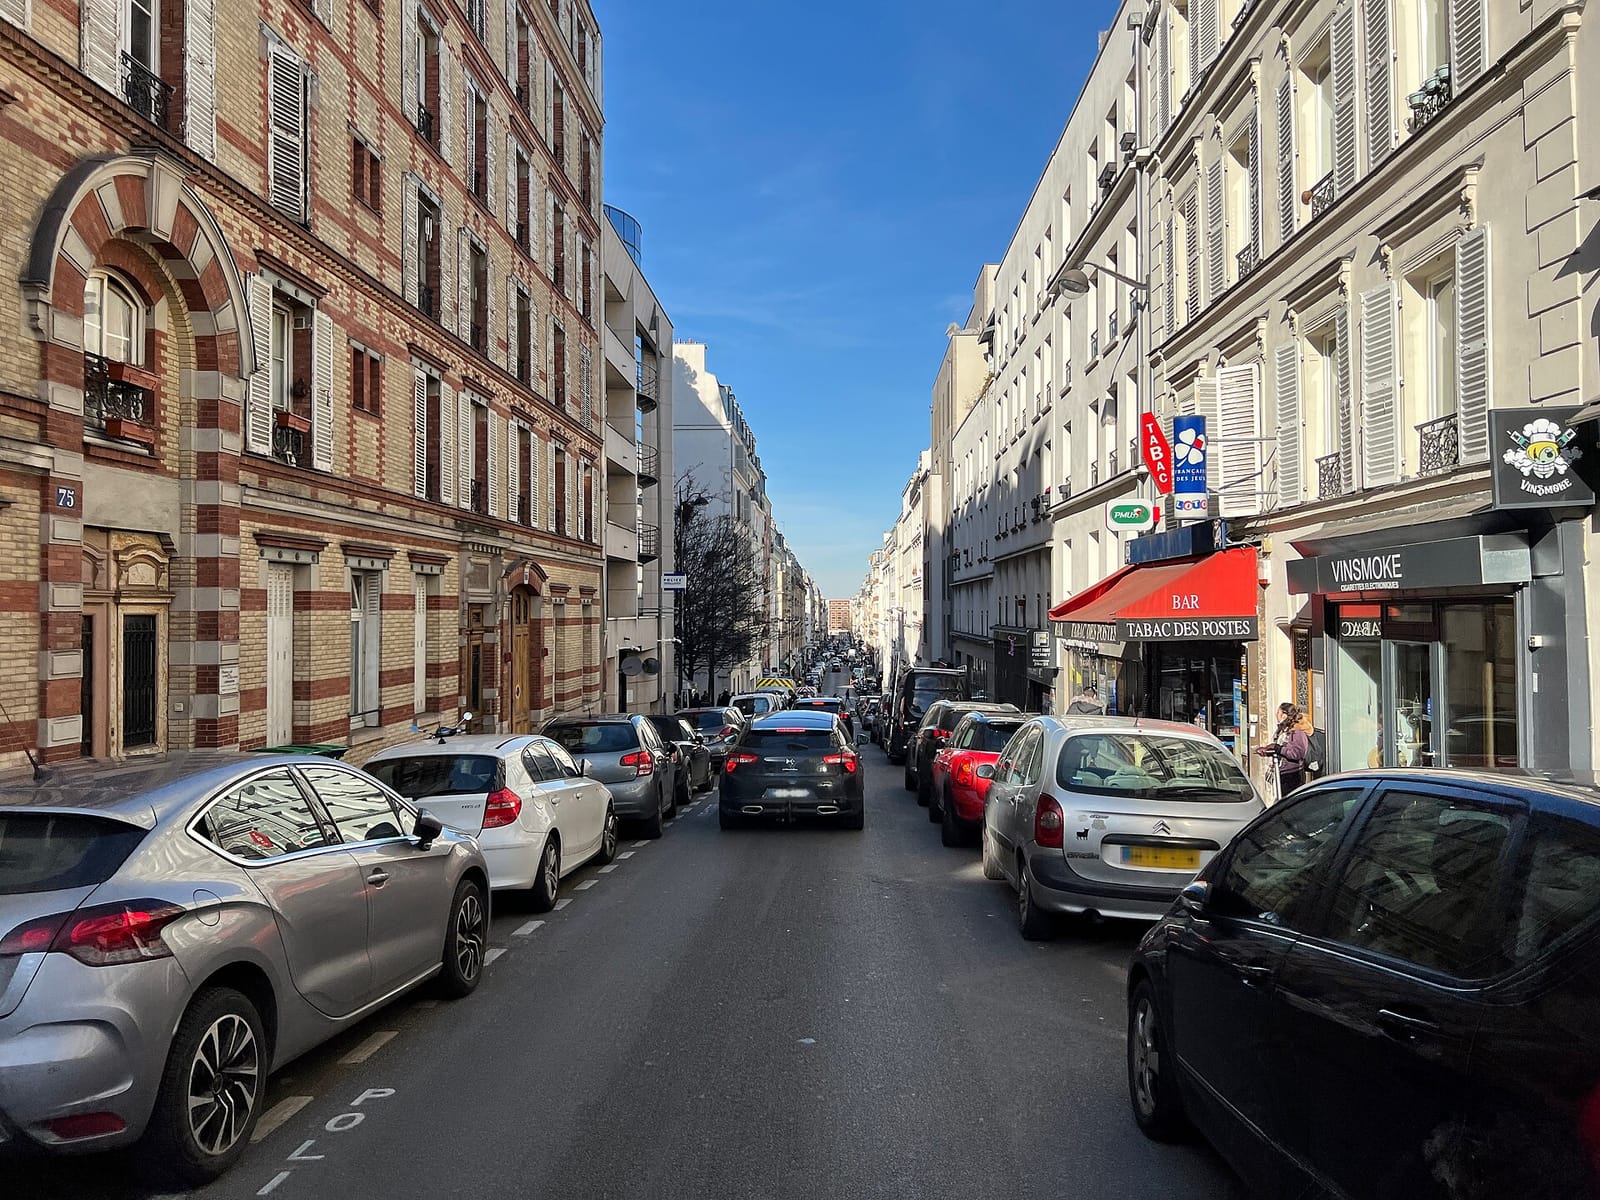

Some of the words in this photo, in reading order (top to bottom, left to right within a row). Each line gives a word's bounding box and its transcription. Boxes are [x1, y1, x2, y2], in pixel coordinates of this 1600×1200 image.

[1145, 423, 1168, 483] TABAC
[1520, 478, 1573, 497] VINSMOKE
[58, 488, 75, 507] 75
[1176, 499, 1208, 511] LOTO
[1113, 511, 1135, 519] PMU
[1331, 553, 1403, 582] VINSMOKE
[1172, 594, 1200, 610] BAR
[1126, 622, 1172, 638] TABAC
[1174, 621, 1200, 637] DES
[1202, 620, 1251, 636] POSTES
